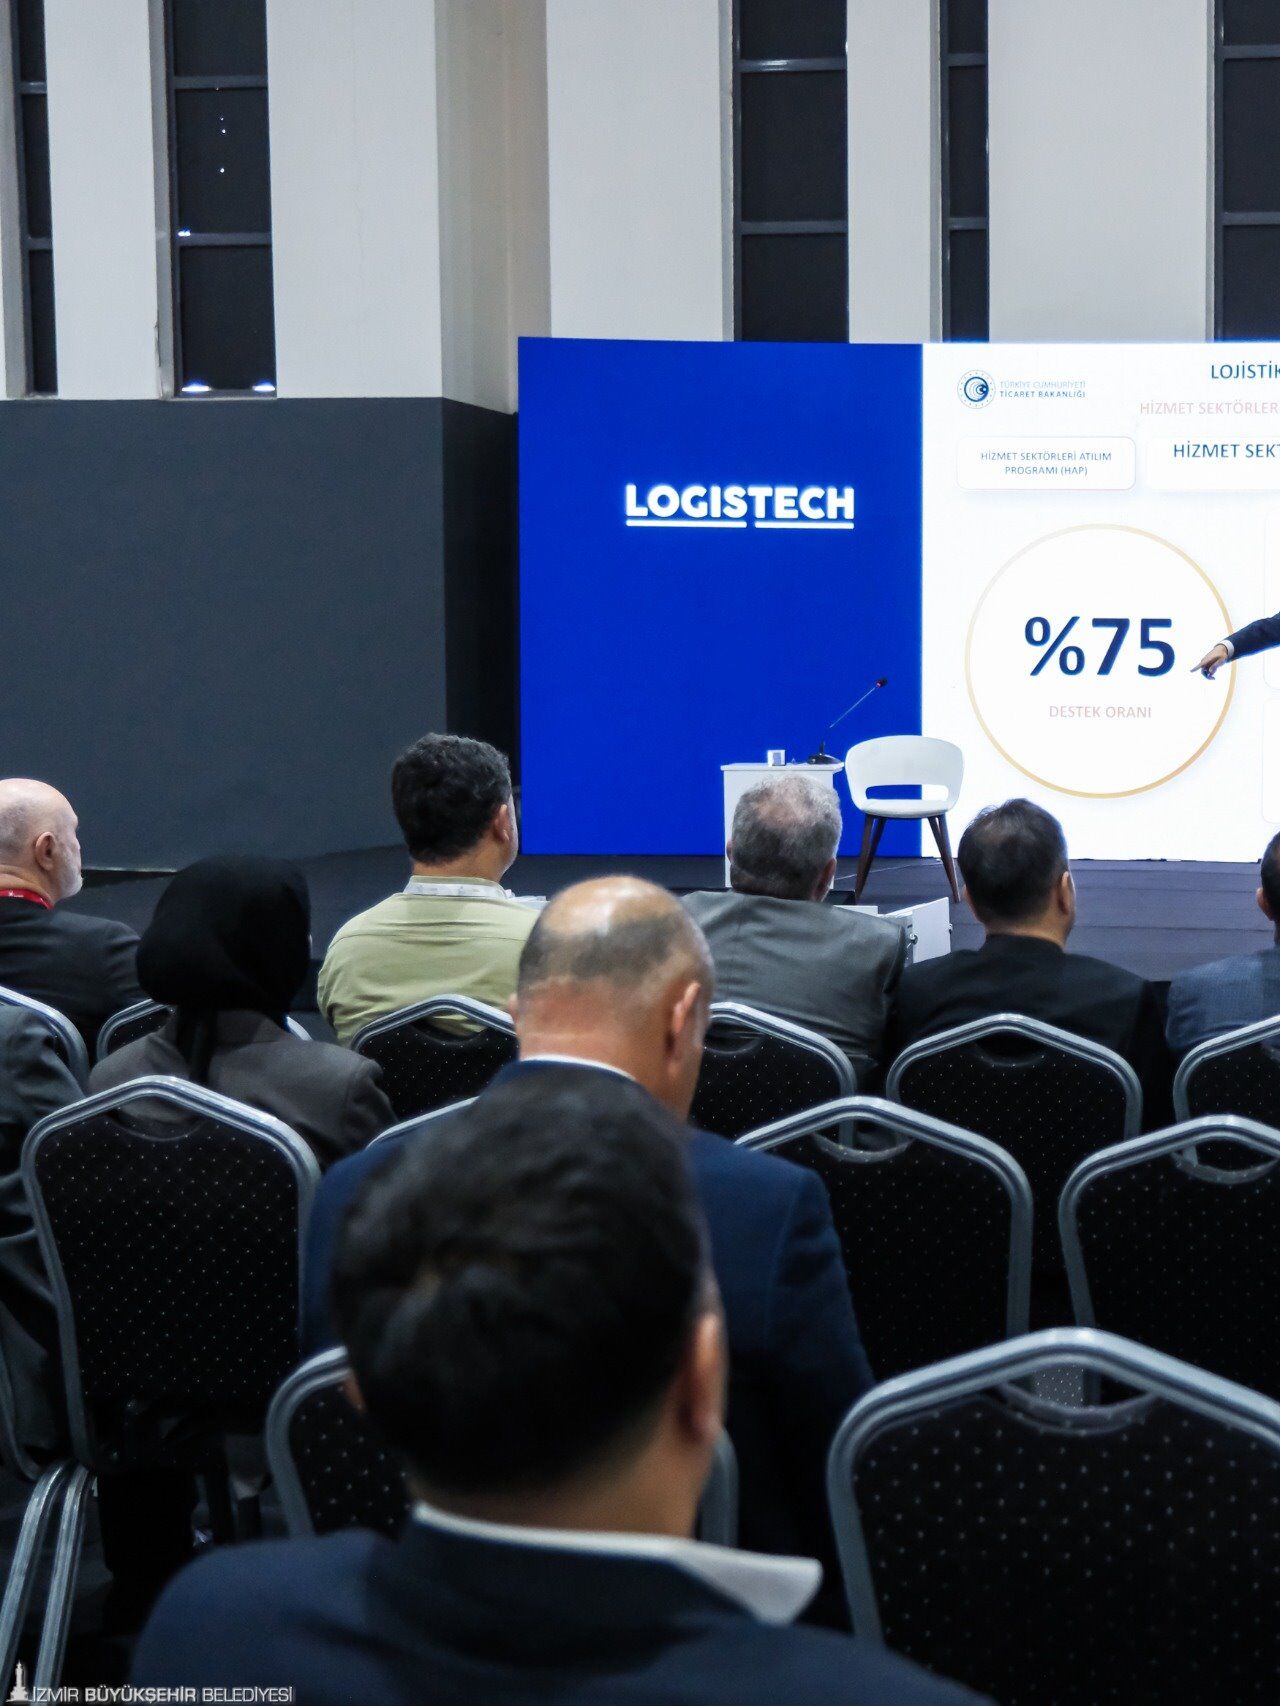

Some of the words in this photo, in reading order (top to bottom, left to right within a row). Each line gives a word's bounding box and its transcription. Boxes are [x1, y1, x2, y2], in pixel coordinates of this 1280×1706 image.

[1000, 390, 1036, 398] TİCARET
[1038, 389, 1086, 398] BAKANLIĞI
[1140, 400, 1195, 415] HİZMET
[981, 451, 1018, 461] HİZMET
[1020, 452, 1077, 461] SEKTÖRLERİ
[1079, 452, 1112, 461] ATILIM
[1174, 440, 1240, 458] HİZMET
[1004, 466, 1058, 475] PROGRAMI
[1060, 466, 1088, 477] (HAP)
[626, 484, 855, 520] LOGISTECH
[1024, 615, 1176, 678] %75
[1049, 705, 1101, 718] DESTEK
[1105, 706, 1152, 719] ORANI
